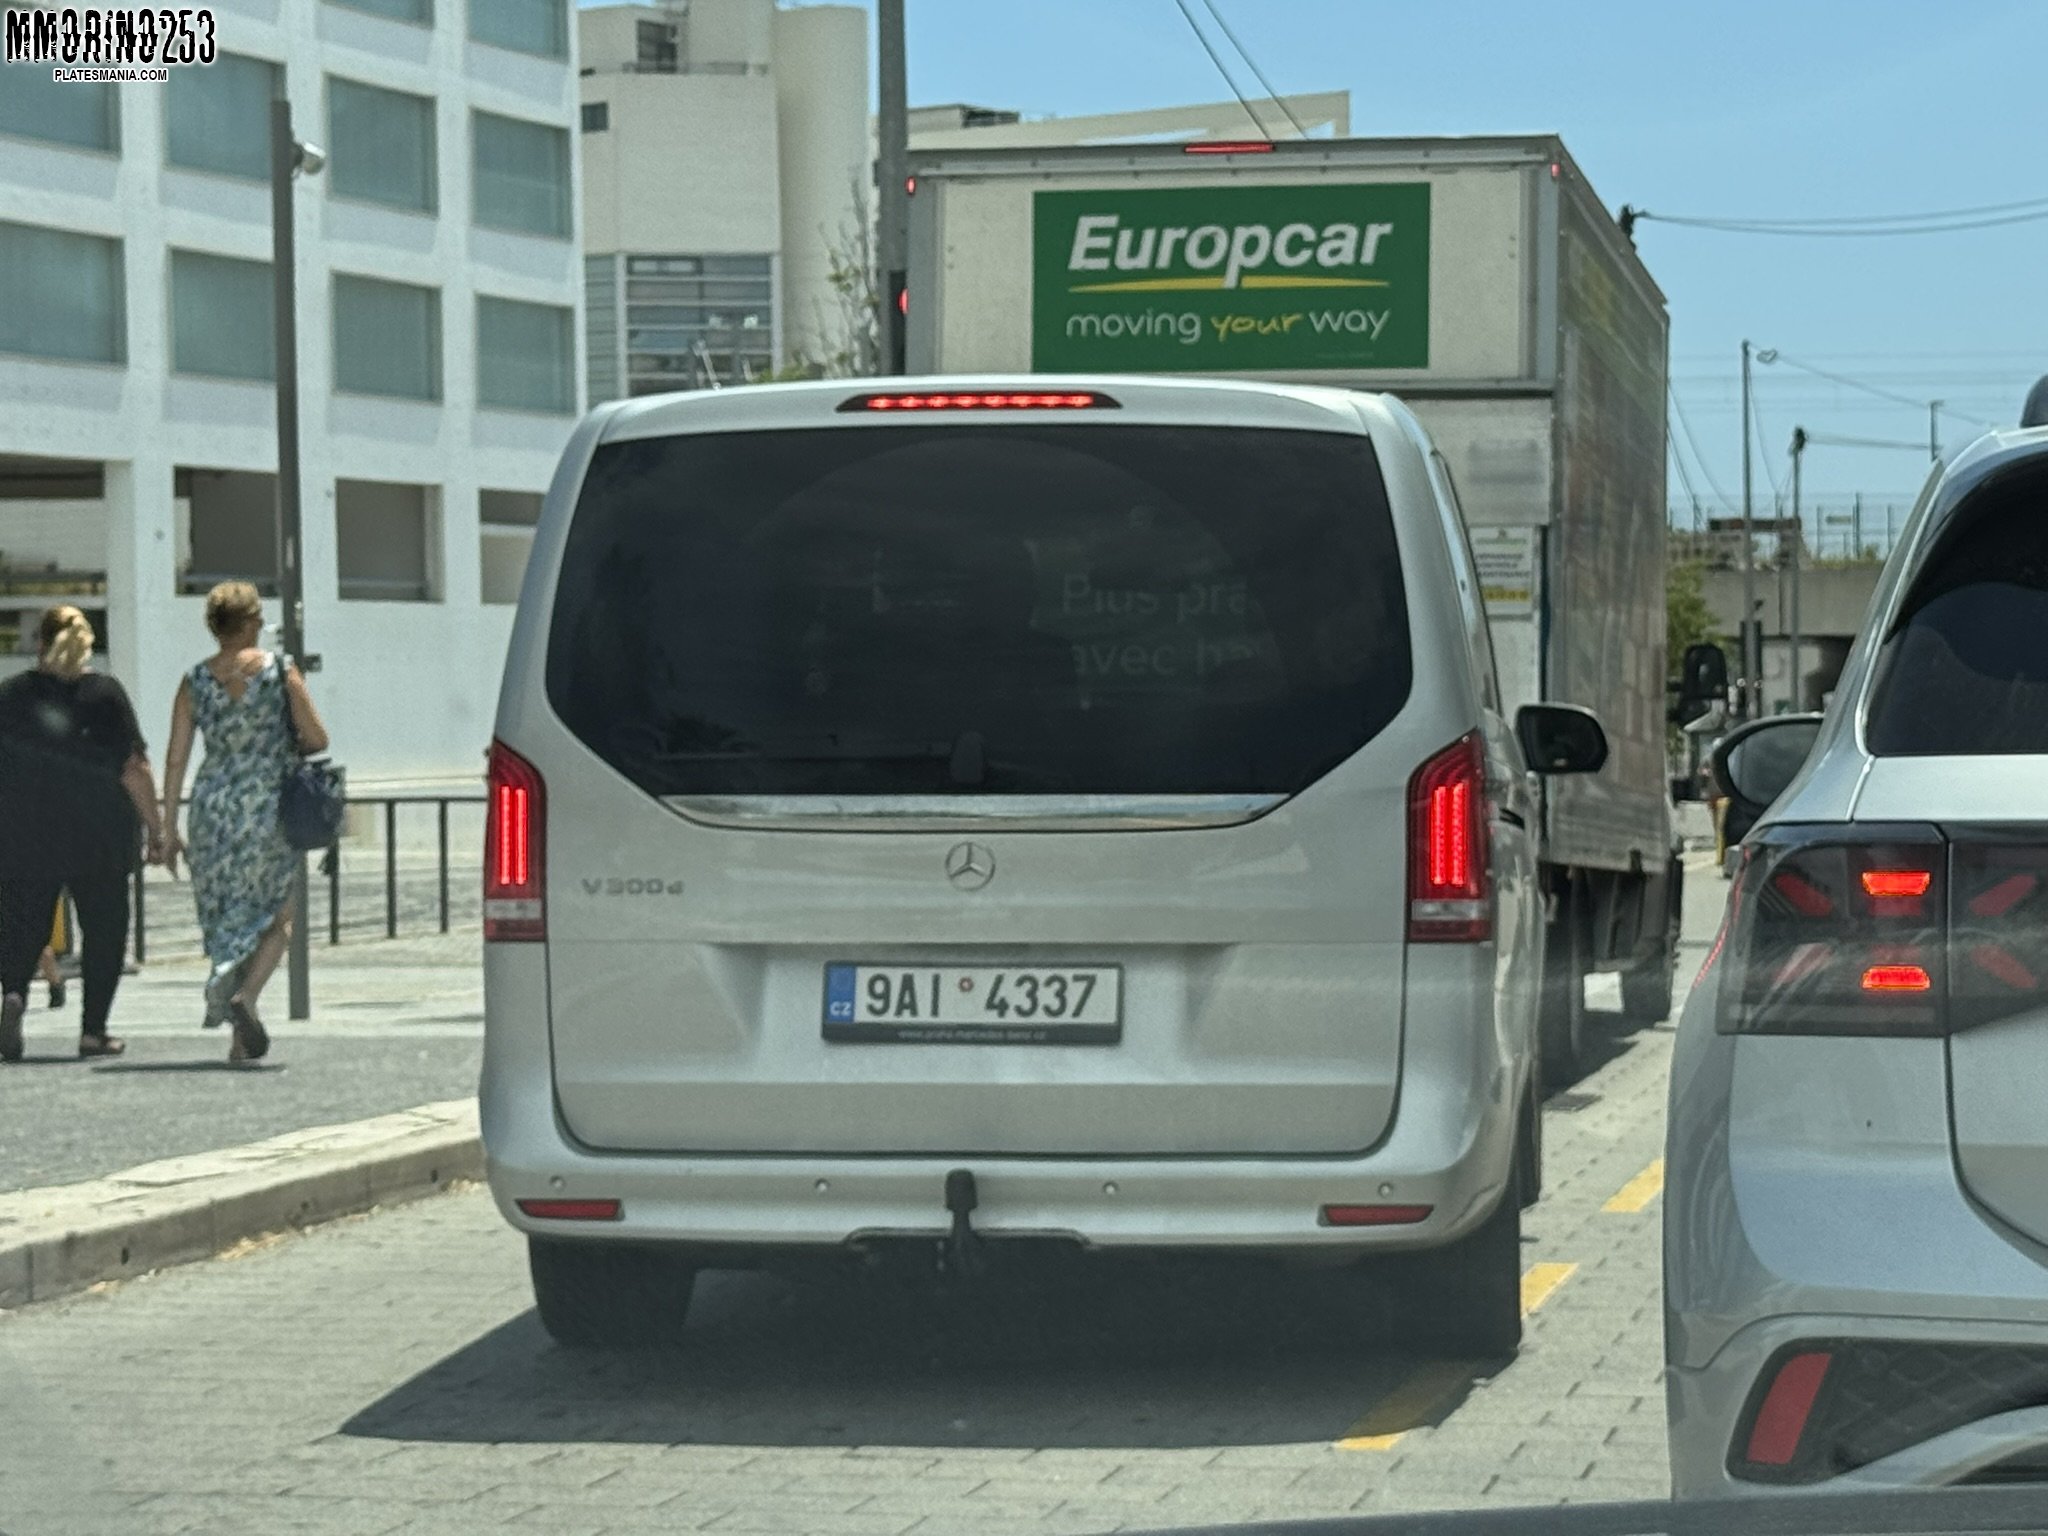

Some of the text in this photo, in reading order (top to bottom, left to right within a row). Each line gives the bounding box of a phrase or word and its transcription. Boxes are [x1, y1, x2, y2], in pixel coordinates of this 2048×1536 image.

[1068, 213, 1394, 289] Europcar
[1066, 309, 1390, 345] moving your way
[829, 1001, 851, 1016] CZ
[865, 973, 1098, 1018] 9AI 4337
